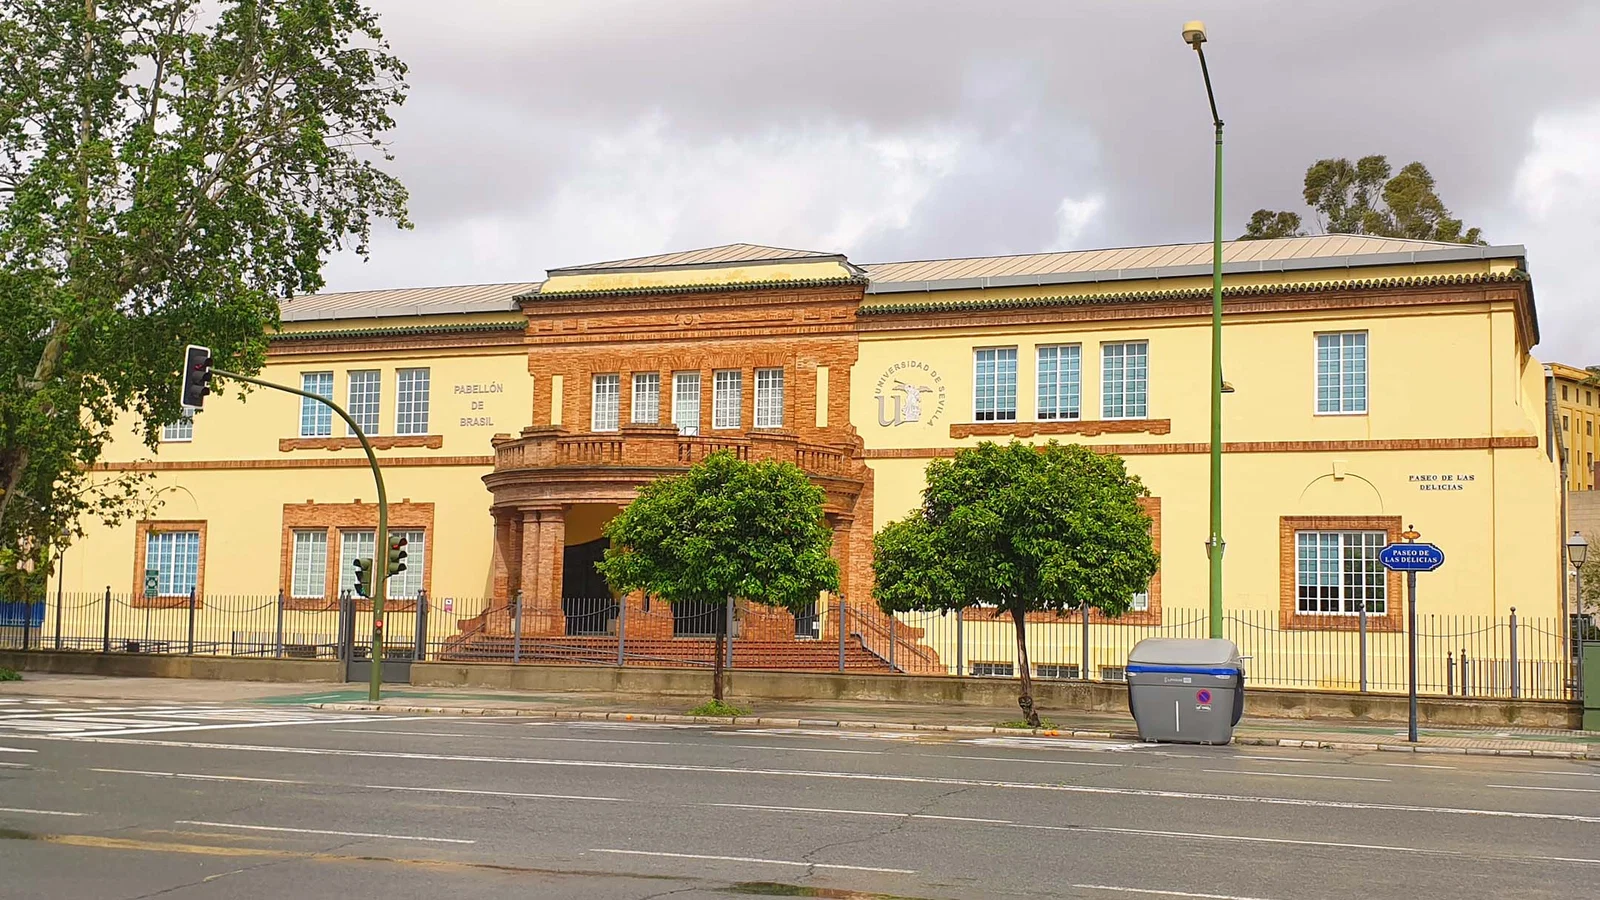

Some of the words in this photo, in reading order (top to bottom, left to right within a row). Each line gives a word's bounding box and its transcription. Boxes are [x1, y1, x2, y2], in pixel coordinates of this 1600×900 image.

[874, 360, 930, 394] UNIVERSIDAD
[930, 370, 942, 384] DE
[454, 381, 503, 394] PABELLÓN
[472, 401, 484, 410] DE
[926, 386, 946, 426] SEVILLA
[460, 417, 494, 426] BRASIL
